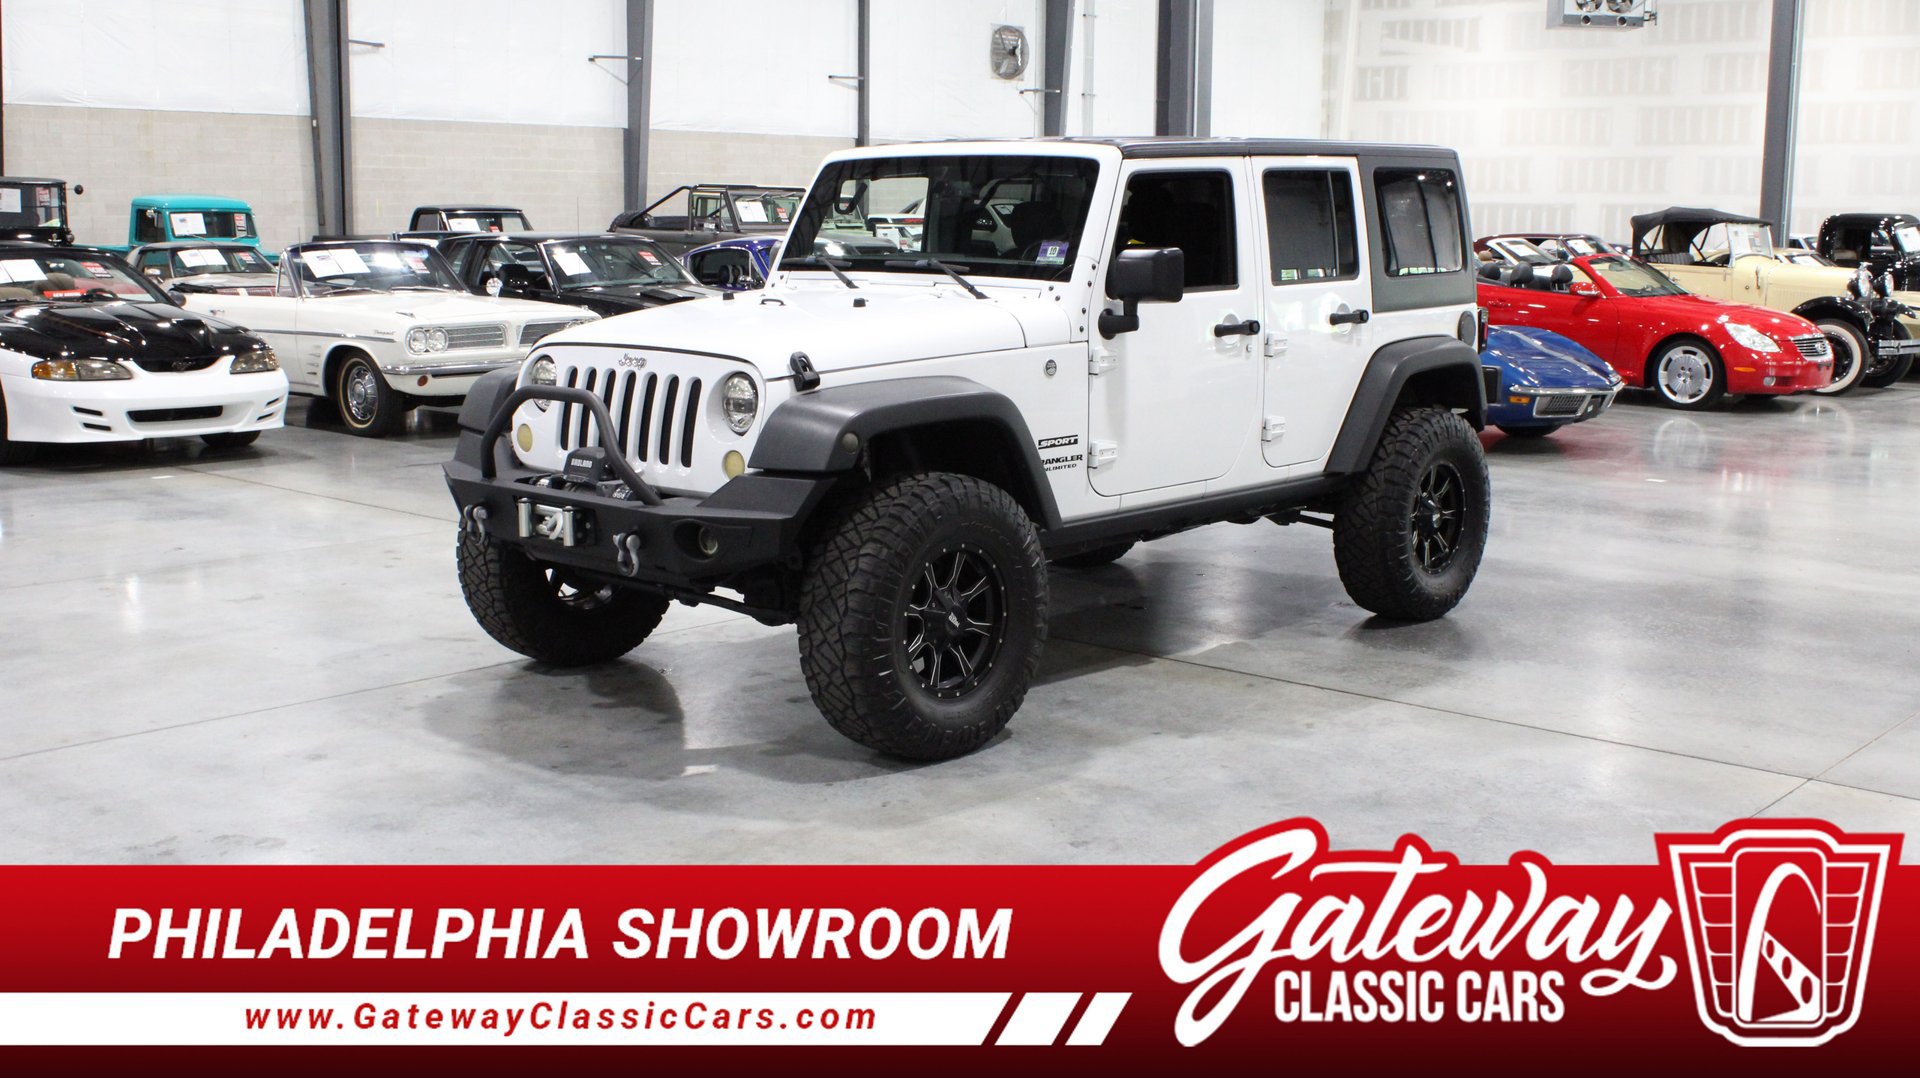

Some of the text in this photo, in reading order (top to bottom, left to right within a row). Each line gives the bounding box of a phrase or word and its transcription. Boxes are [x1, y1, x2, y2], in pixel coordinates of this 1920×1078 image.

[618, 352, 647, 371] Jeep
[1039, 436, 1077, 448] SPORT
[570, 457, 593, 469] BADLAND
[1040, 454, 1083, 465] RANGLER
[1045, 463, 1077, 472] NLIMITED
